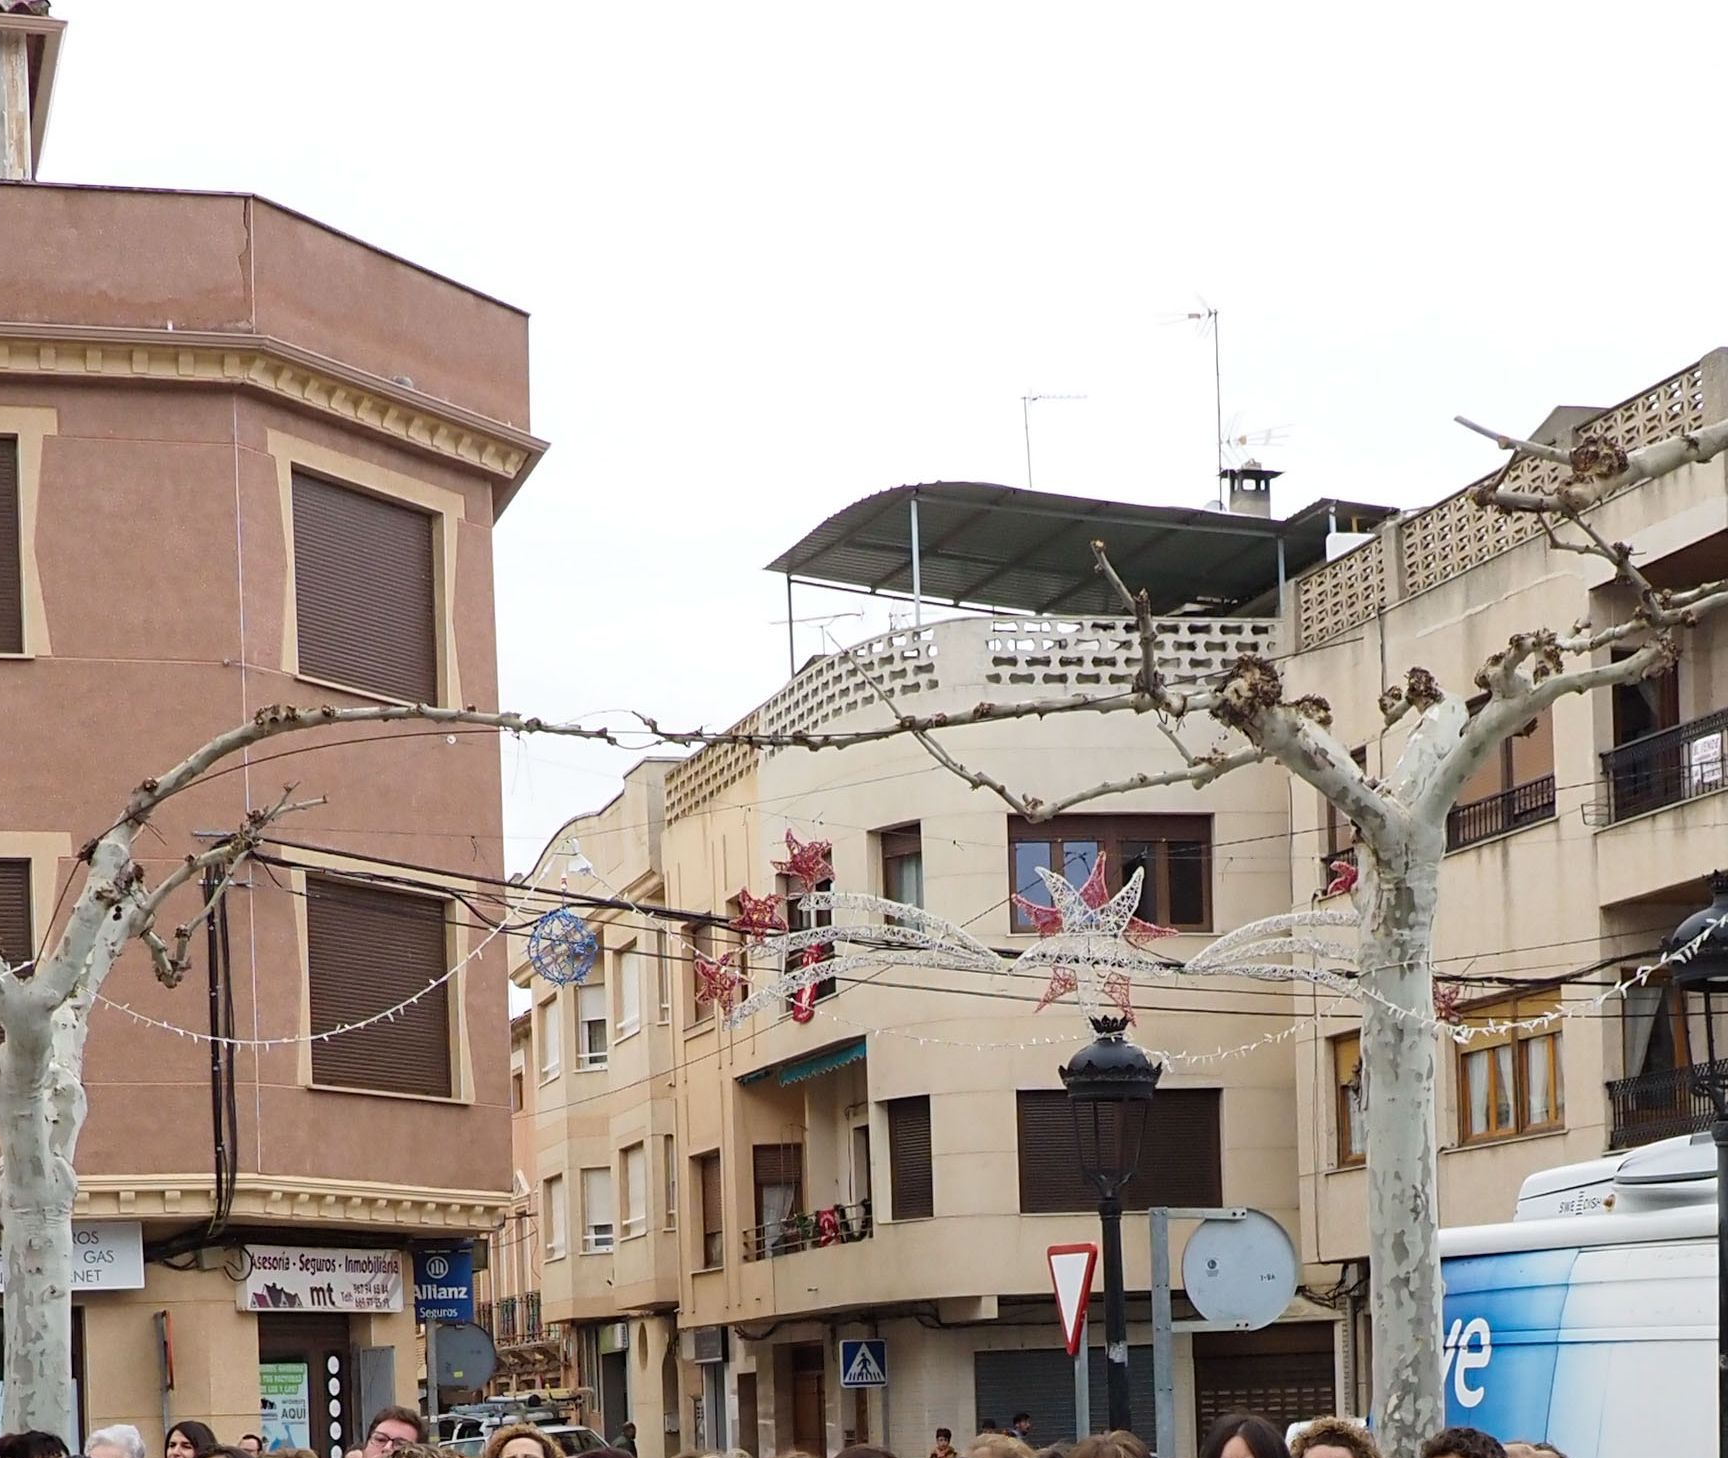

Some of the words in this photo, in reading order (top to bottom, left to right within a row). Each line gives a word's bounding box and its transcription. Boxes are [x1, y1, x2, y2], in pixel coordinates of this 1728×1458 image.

[83, 1250, 115, 1264] GAS
[299, 1253, 336, 1276] Seguros
[309, 1282, 336, 1306] mt
[414, 1284, 468, 1300] Allianz
[420, 1307, 458, 1319] Seguros
